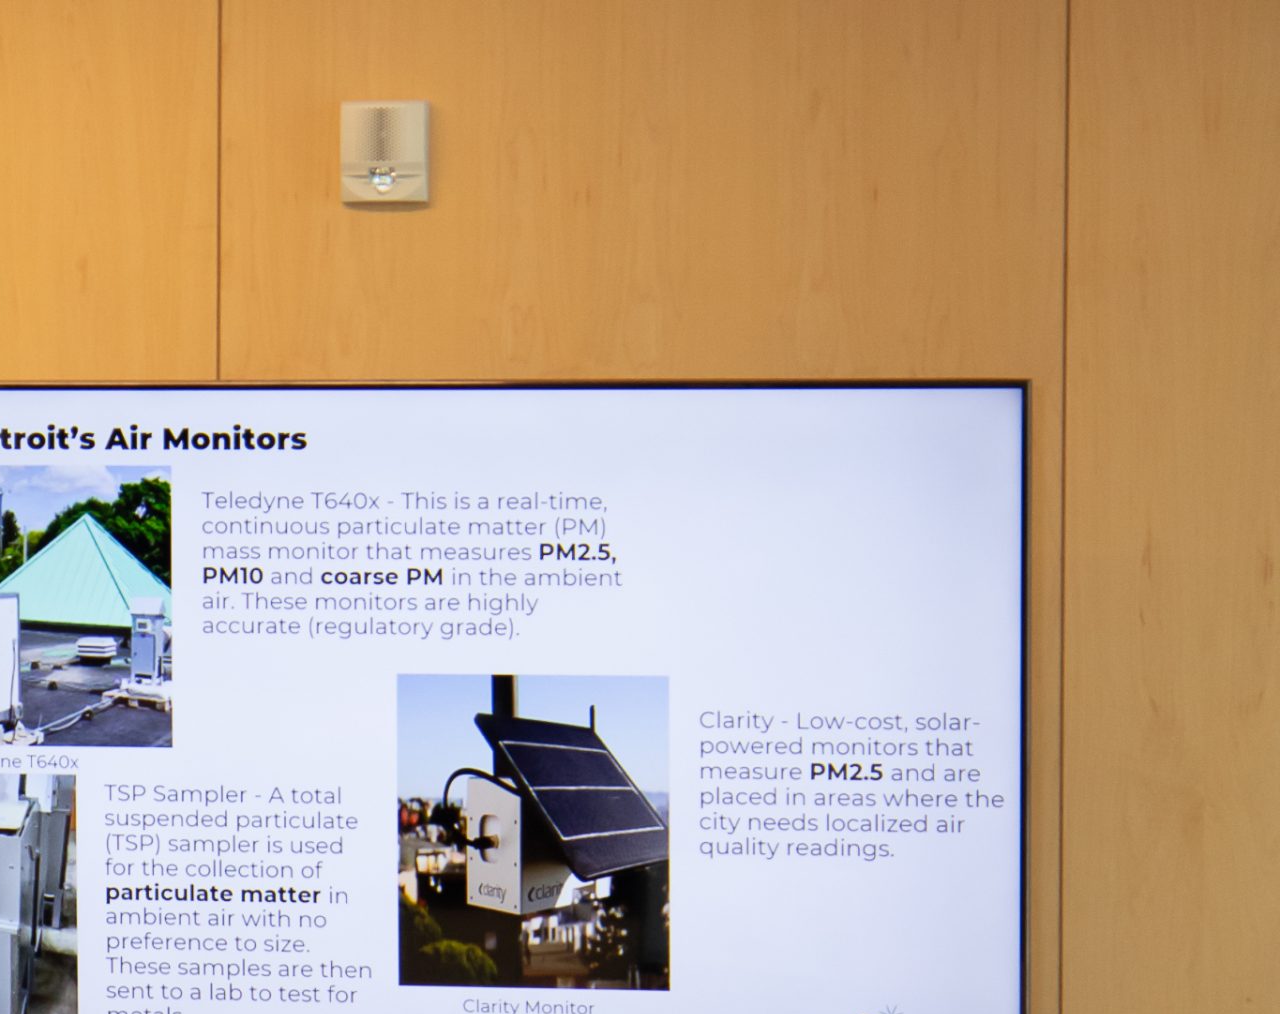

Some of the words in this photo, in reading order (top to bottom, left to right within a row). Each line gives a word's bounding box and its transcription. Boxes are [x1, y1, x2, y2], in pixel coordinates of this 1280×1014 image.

[104, 423, 153, 451] Air
[162, 423, 308, 451] Monitors
[200, 490, 305, 515] Teledyne
[309, 491, 381, 511] T640x
[400, 490, 448, 511] This
[453, 490, 472, 511] is
[476, 495, 490, 511] a
[497, 491, 608, 515] real-time,
[201, 515, 331, 537] continuous
[336, 515, 462, 543] particulate
[468, 519, 547, 537] matter
[554, 516, 607, 541] (PM)
[202, 545, 262, 561] mass
[267, 540, 360, 561] monitor
[365, 540, 413, 561] that
[420, 546, 533, 562] measures
[538, 542, 618, 566] PM2.5,
[202, 565, 265, 586] PM10
[270, 565, 314, 586] and
[319, 570, 400, 587] coarse
[406, 567, 444, 587] PM
[451, 566, 472, 587] in
[477, 566, 518, 587] the
[523, 567, 624, 588] ambient
[201, 590, 236, 611] air.
[240, 591, 308, 611] These
[314, 591, 419, 612] monitors
[423, 596, 461, 612] are
[467, 591, 540, 619] highly
[201, 618, 302, 636] accurate
[308, 615, 435, 641] (regulatory
[439, 616, 521, 641] grade).
[698, 709, 775, 735] Clarity
[796, 711, 909, 735] Low-cost,
[914, 711, 981, 732] solar-
[699, 735, 804, 759] powered
[811, 736, 919, 757] monitors
[923, 736, 975, 758] that
[25, 753, 80, 770] T640x
[699, 765, 803, 782] measure
[809, 761, 884, 782] PM2.5
[890, 762, 936, 783] and
[943, 767, 982, 783] are
[103, 783, 147, 803] TSP
[152, 783, 248, 808] Sampler
[267, 786, 286, 805] A
[290, 785, 342, 806] total
[699, 785, 778, 810] placed
[785, 786, 807, 807] in
[813, 791, 878, 808] areas
[882, 787, 959, 809] where
[963, 788, 1006, 809] the
[104, 808, 229, 832] suspended
[235, 809, 359, 833] particulate
[698, 811, 741, 836] city
[747, 812, 819, 832] needs
[825, 812, 929, 834] localized
[935, 813, 966, 834] air
[105, 832, 161, 857] (TSP)
[167, 833, 260, 858] sampler
[266, 834, 284, 855] is
[289, 835, 344, 855] used
[698, 836, 780, 861] quality
[786, 837, 895, 863] readings.
[104, 856, 135, 877] for
[140, 857, 179, 878] the
[184, 858, 294, 880] collection
[300, 859, 324, 880] of
[105, 881, 234, 906] particulate
[240, 885, 323, 905] matter
[328, 885, 349, 905] in
[105, 906, 202, 929] ambient
[207, 907, 236, 928] air
[240, 908, 291, 929] with
[298, 914, 329, 929] no
[106, 931, 228, 958] preference
[233, 935, 258, 953] to
[263, 933, 311, 954] size.
[104, 954, 173, 978] These
[176, 957, 272, 984] samples
[277, 963, 314, 979] are
[319, 959, 373, 980] then
[105, 983, 155, 1001] sent
[159, 983, 185, 1001] to
[189, 986, 202, 1001] a
[209, 981, 244, 1002] lab
[248, 985, 273, 1003] to
[277, 986, 321, 1004] test
[325, 983, 359, 1004] for
